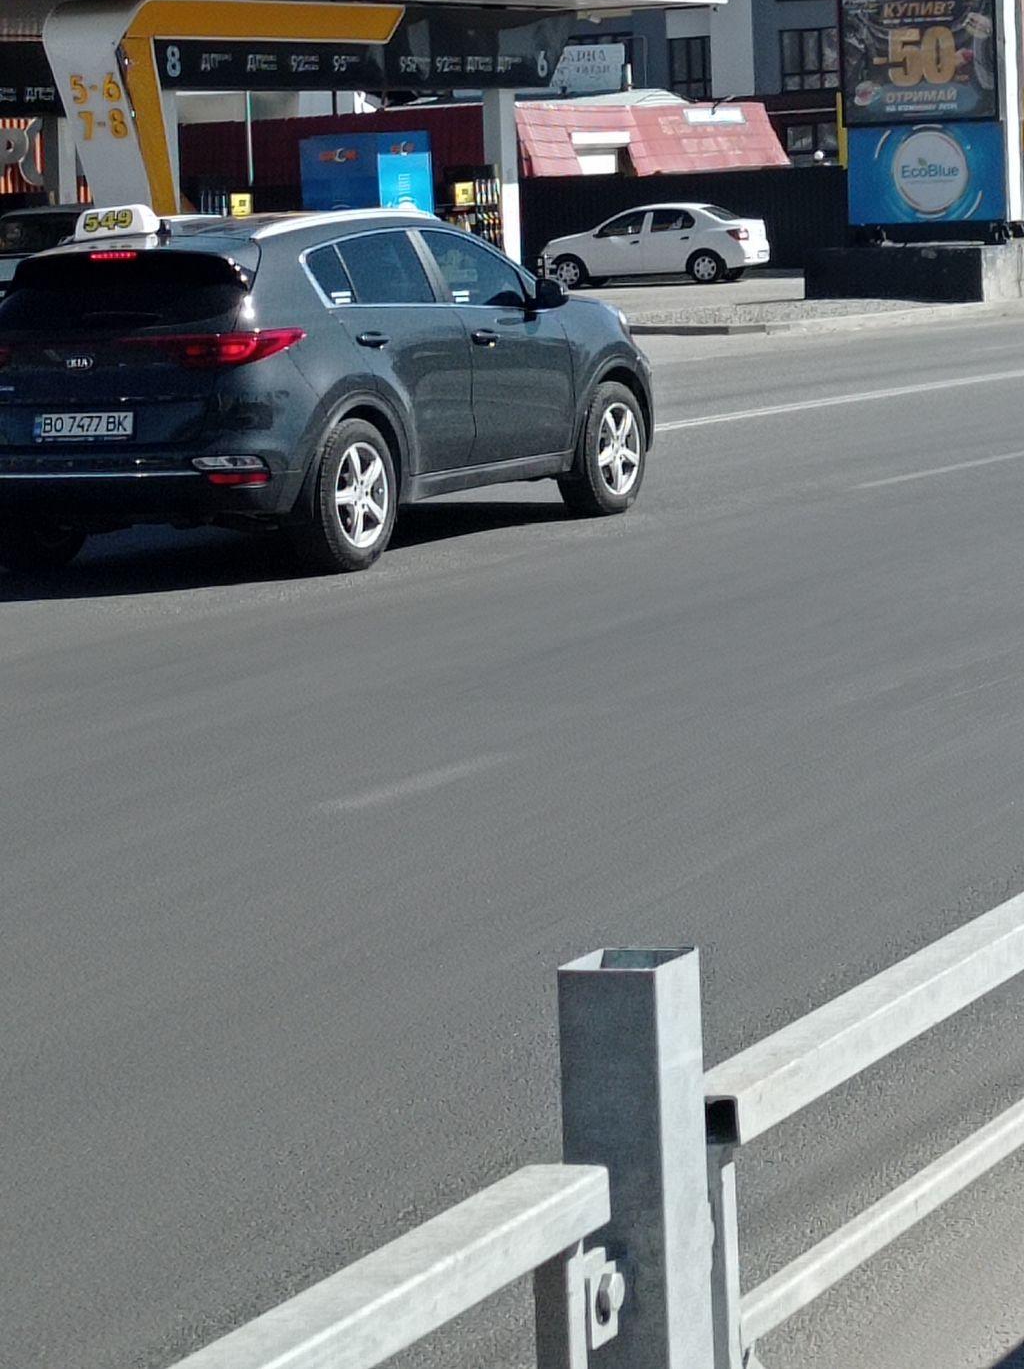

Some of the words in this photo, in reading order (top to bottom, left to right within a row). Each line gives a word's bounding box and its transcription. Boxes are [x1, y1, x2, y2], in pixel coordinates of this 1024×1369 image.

[166, 44, 182, 77] 8
[537, 50, 548, 78] 6
[901, 163, 960, 179] EcoBlue
[83, 209, 133, 232] 549
[42, 417, 64, 433] BO
[68, 416, 102, 433] 7477
[105, 415, 128, 432] BK
